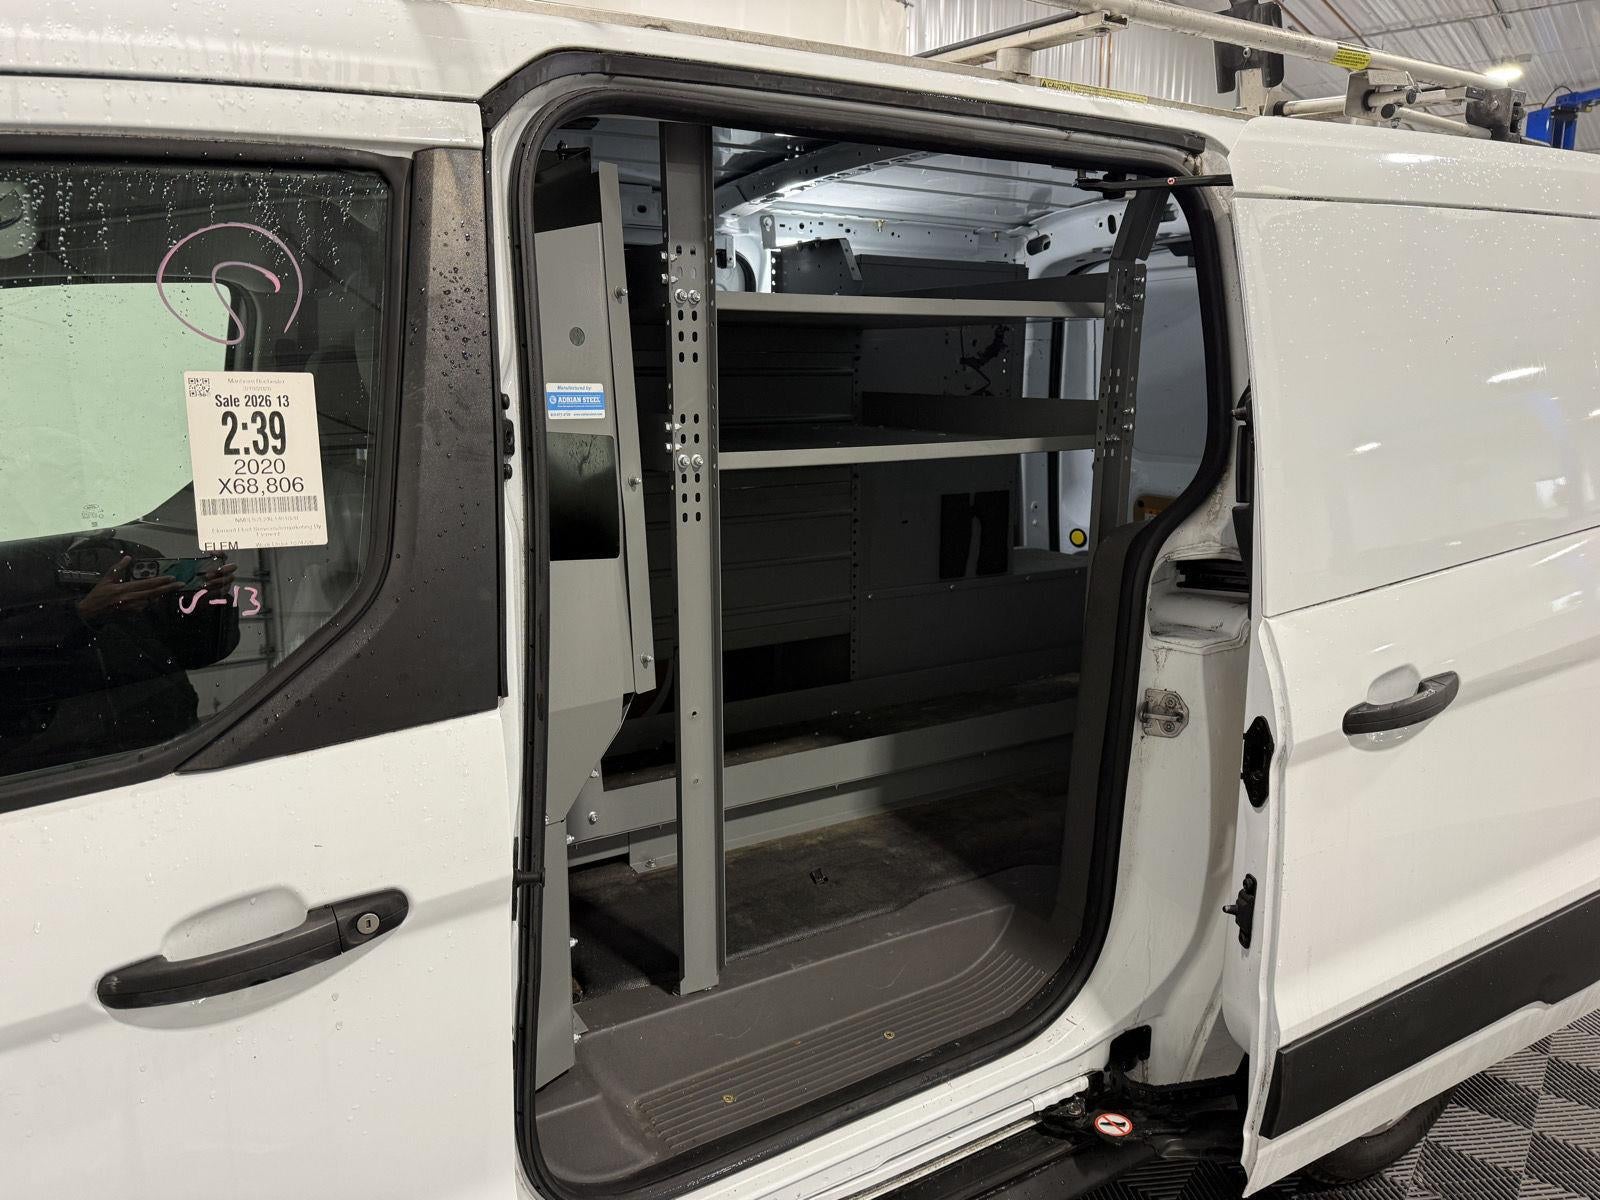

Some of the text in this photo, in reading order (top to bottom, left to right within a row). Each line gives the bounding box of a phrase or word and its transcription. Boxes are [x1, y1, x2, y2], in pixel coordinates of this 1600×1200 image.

[1047, 80, 1071, 92] CAUTION
[215, 394, 290, 407] Sale 2026 13
[221, 410, 287, 456] 2:39
[234, 458, 286, 475] 2020
[218, 476, 304, 496] X68,806
